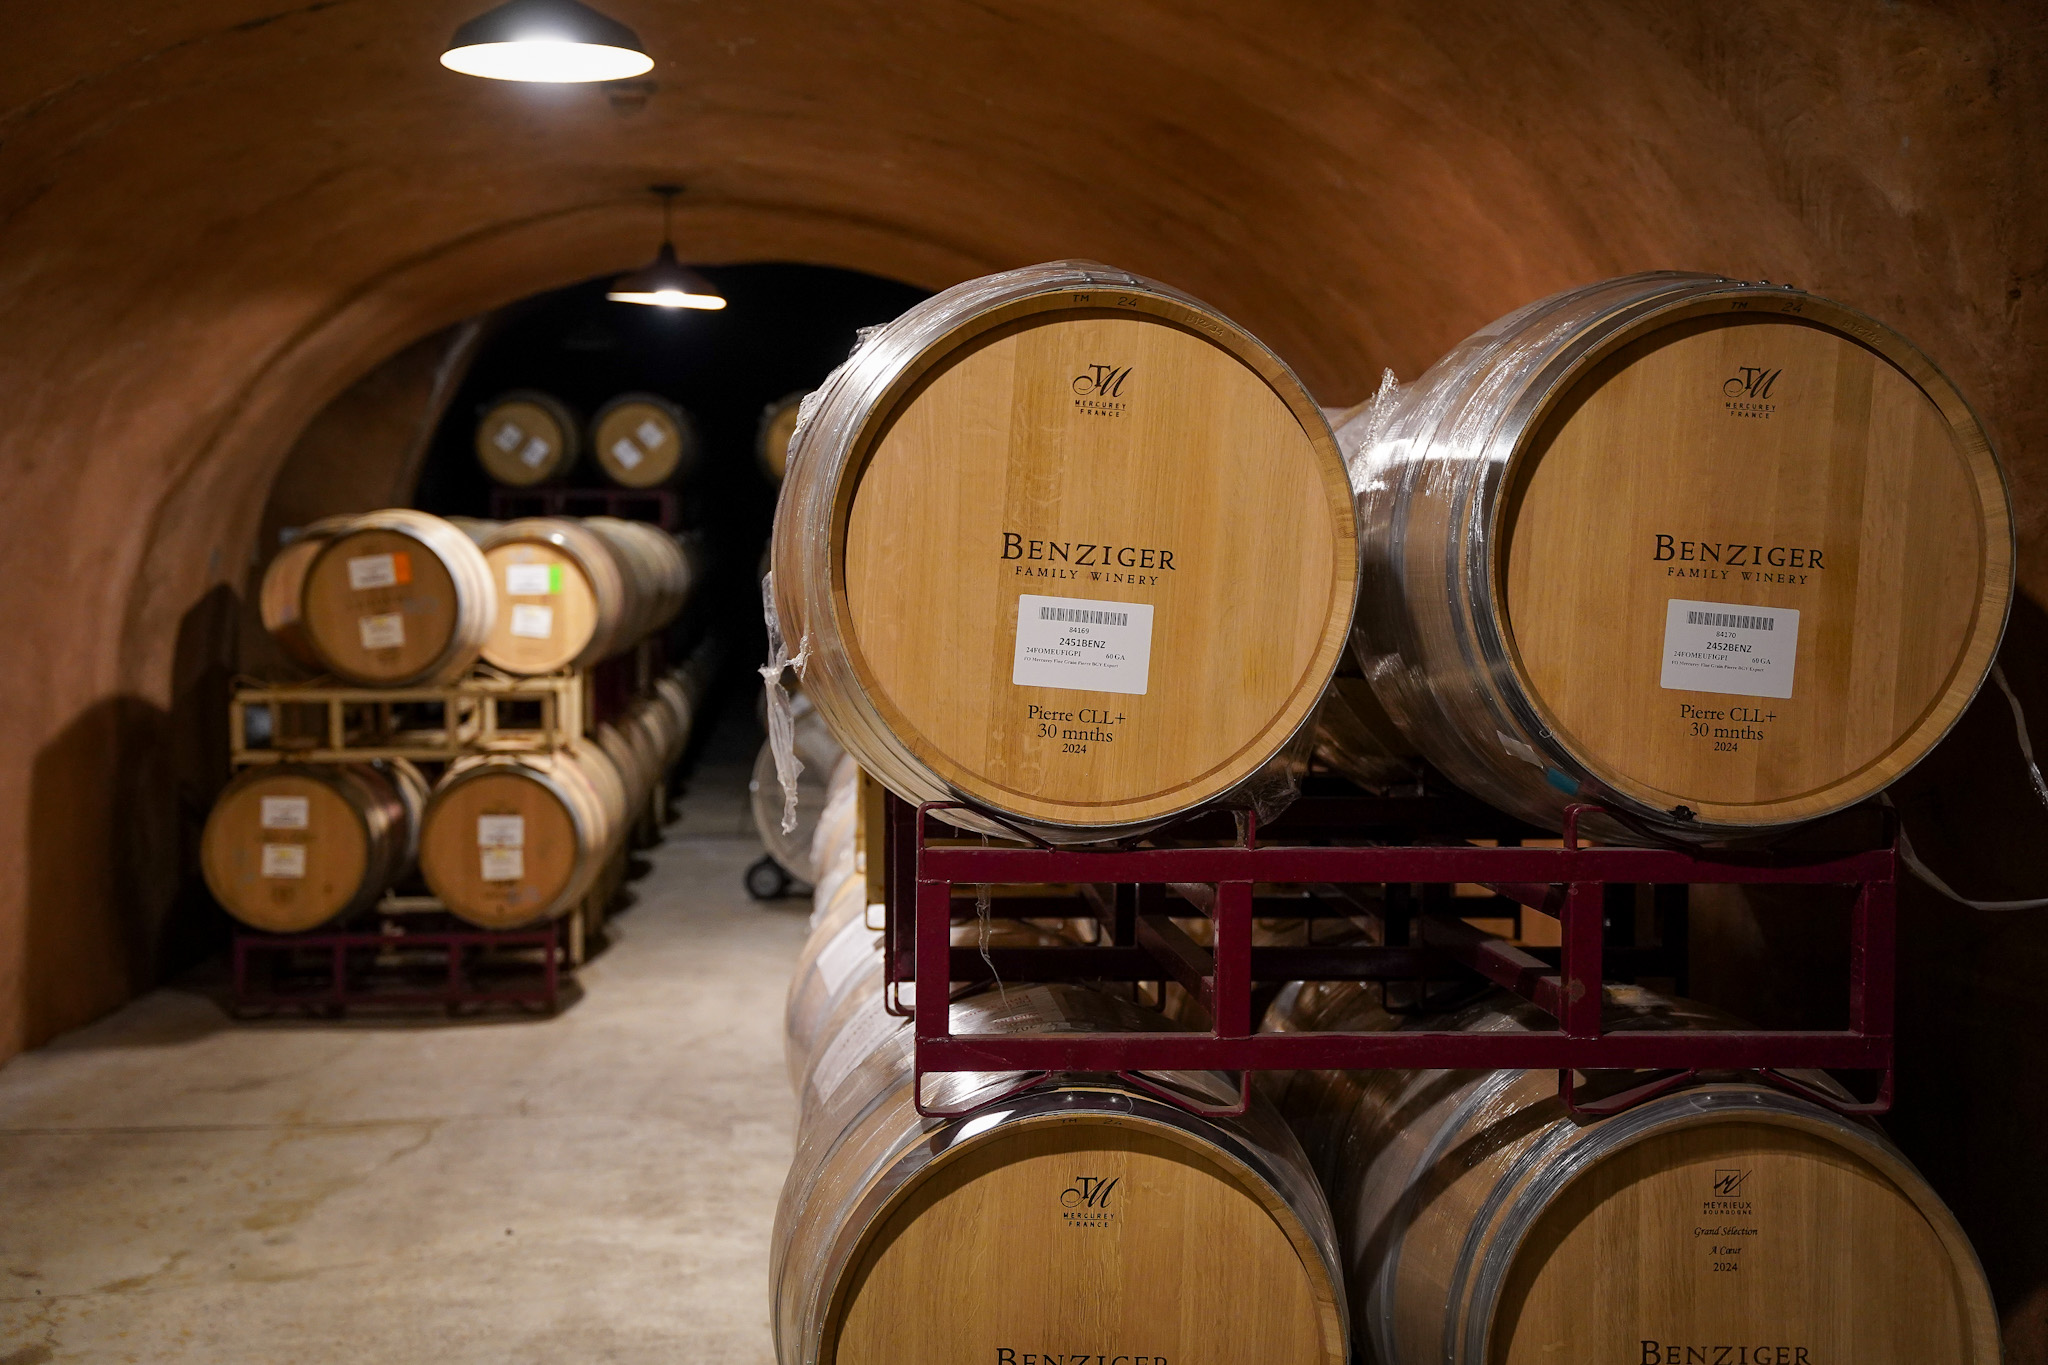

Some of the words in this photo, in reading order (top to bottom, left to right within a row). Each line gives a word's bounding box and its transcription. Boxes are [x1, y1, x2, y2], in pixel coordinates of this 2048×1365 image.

[1072, 294, 1090, 302] TM
[1117, 296, 1138, 308] 24
[1731, 302, 1748, 310] TM
[1781, 302, 1803, 313] 24
[1075, 400, 1126, 410] MERCUREY
[1725, 402, 1776, 411] MERCUREY
[1080, 408, 1120, 418] FRANCE
[1730, 411, 1770, 419] FRANCE
[1000, 532, 1176, 571] BENZIGER
[1653, 534, 1826, 570] BENZIGER
[1015, 565, 1079, 580] FAMILY
[1090, 571, 1159, 586] WINERY
[1667, 566, 1730, 580] FAMILY
[1741, 571, 1808, 585] WINERY
[1068, 627, 1090, 635] 84169
[1715, 631, 1737, 639] 84170
[1059, 637, 1106, 649] 2451BENZ
[1706, 641, 1753, 653] 2452BENZ
[1114, 653, 1126, 661] GA
[1027, 704, 1074, 722] Pierre
[1078, 708, 1126, 724] CLL+
[1680, 704, 1725, 720] Pierre
[1729, 707, 1777, 723] CLL+
[1037, 723, 1057, 738] 30
[1062, 727, 1113, 742] mnths
[1689, 722, 1709, 737] 30
[1713, 725, 1764, 741] mnths
[1062, 743, 1087, 754] 2024
[1713, 741, 1738, 752] 2024
[1703, 1201, 1752, 1209] MEYRIEUX
[1694, 1226, 1721, 1238] Grand
[1713, 1262, 1738, 1272] 2024
[1640, 1340, 1812, 1365] BENZIGER
